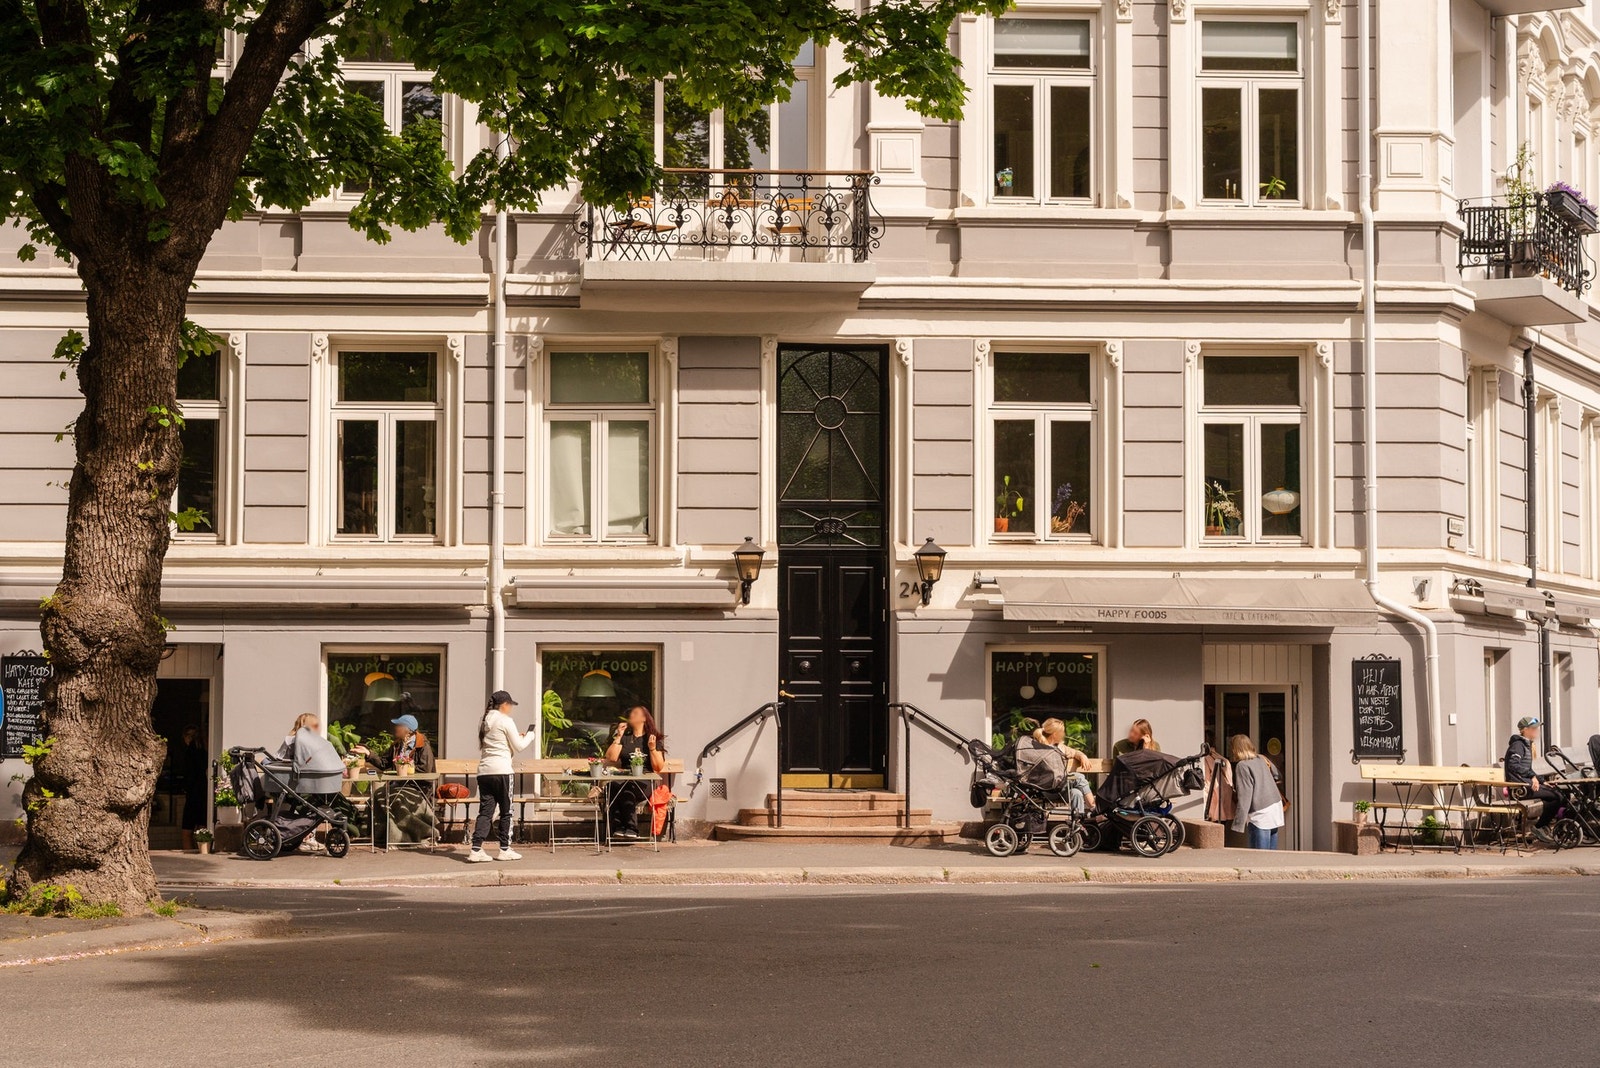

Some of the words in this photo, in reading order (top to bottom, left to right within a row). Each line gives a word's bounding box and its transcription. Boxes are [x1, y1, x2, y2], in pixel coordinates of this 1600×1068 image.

[899, 581, 920, 599] 2A
[1097, 609, 1130, 619] HAPPY
[1134, 610, 1167, 620] FOODS
[4, 664, 29, 679] HAPPY
[335, 662, 382, 673] HAPPY
[386, 662, 433, 674] FOODS
[549, 660, 597, 671] HAPPY
[601, 660, 648, 672] FOODS
[995, 661, 1043, 673] HAPPY
[1047, 661, 1094, 674] FOODS
[1366, 684, 1379, 696] HAR
[1358, 696, 1369, 705] INN
[1370, 696, 1390, 706] NESTE
[1375, 706, 1390, 716] TIL
[1359, 715, 1386, 726] VENSTRE
